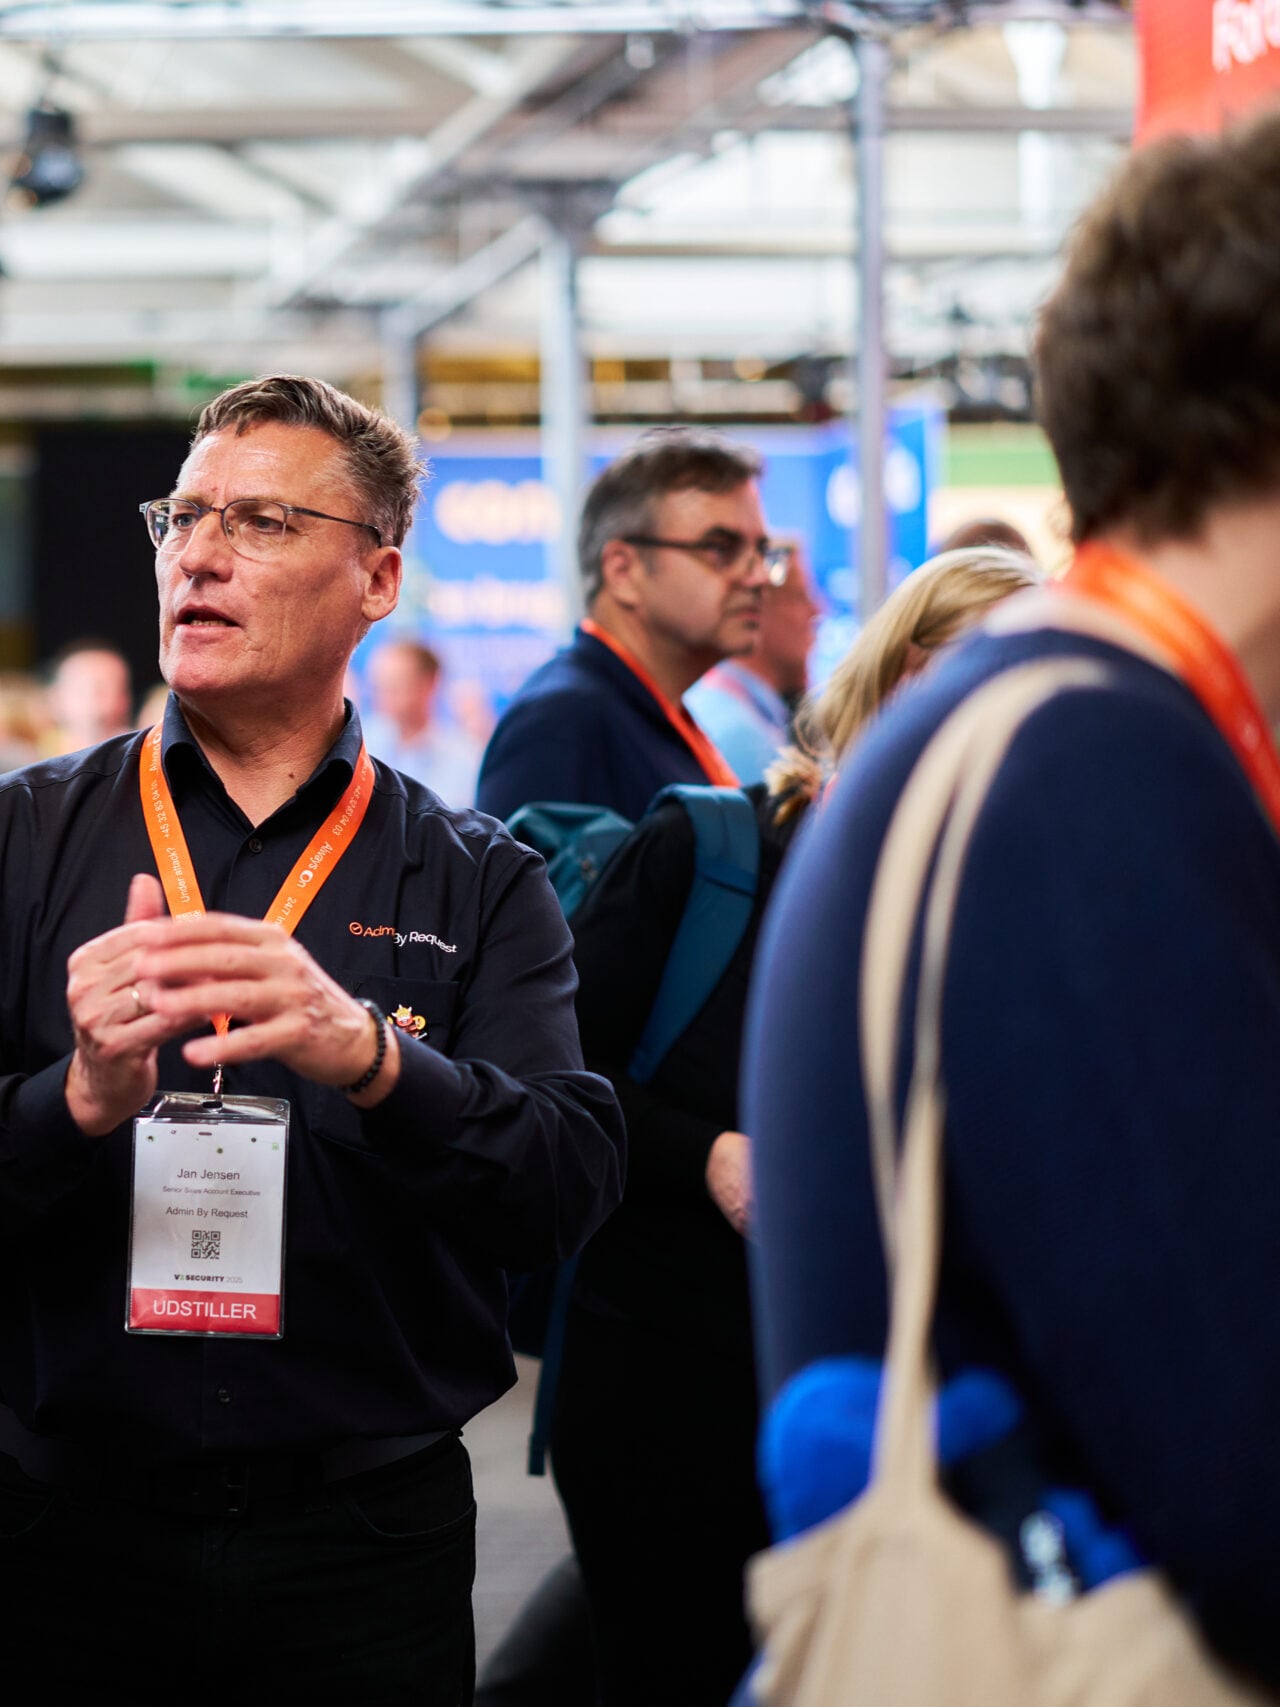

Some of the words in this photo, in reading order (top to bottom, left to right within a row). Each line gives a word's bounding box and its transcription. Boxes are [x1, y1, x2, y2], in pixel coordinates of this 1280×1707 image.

[153, 800, 163, 812] 83
[157, 811, 167, 823] 32
[340, 814, 350, 826] 04
[332, 824, 344, 836] 03
[166, 847, 182, 877] attack?
[308, 841, 333, 870] Always
[296, 869, 314, 888] On
[177, 878, 191, 903] Under
[281, 896, 297, 916] 24/7
[363, 924, 396, 937] Adm
[408, 931, 458, 953] Request
[176, 1168, 197, 1179] Jan
[200, 1169, 241, 1181] Jensen
[162, 1185, 182, 1193] Senior
[230, 1188, 261, 1197] Executive
[165, 1206, 195, 1216] Admin
[196, 1207, 209, 1218] By
[211, 1208, 248, 1219] Request
[185, 1274, 225, 1282] SECURITY
[153, 1299, 257, 1320] UDSTILLER
